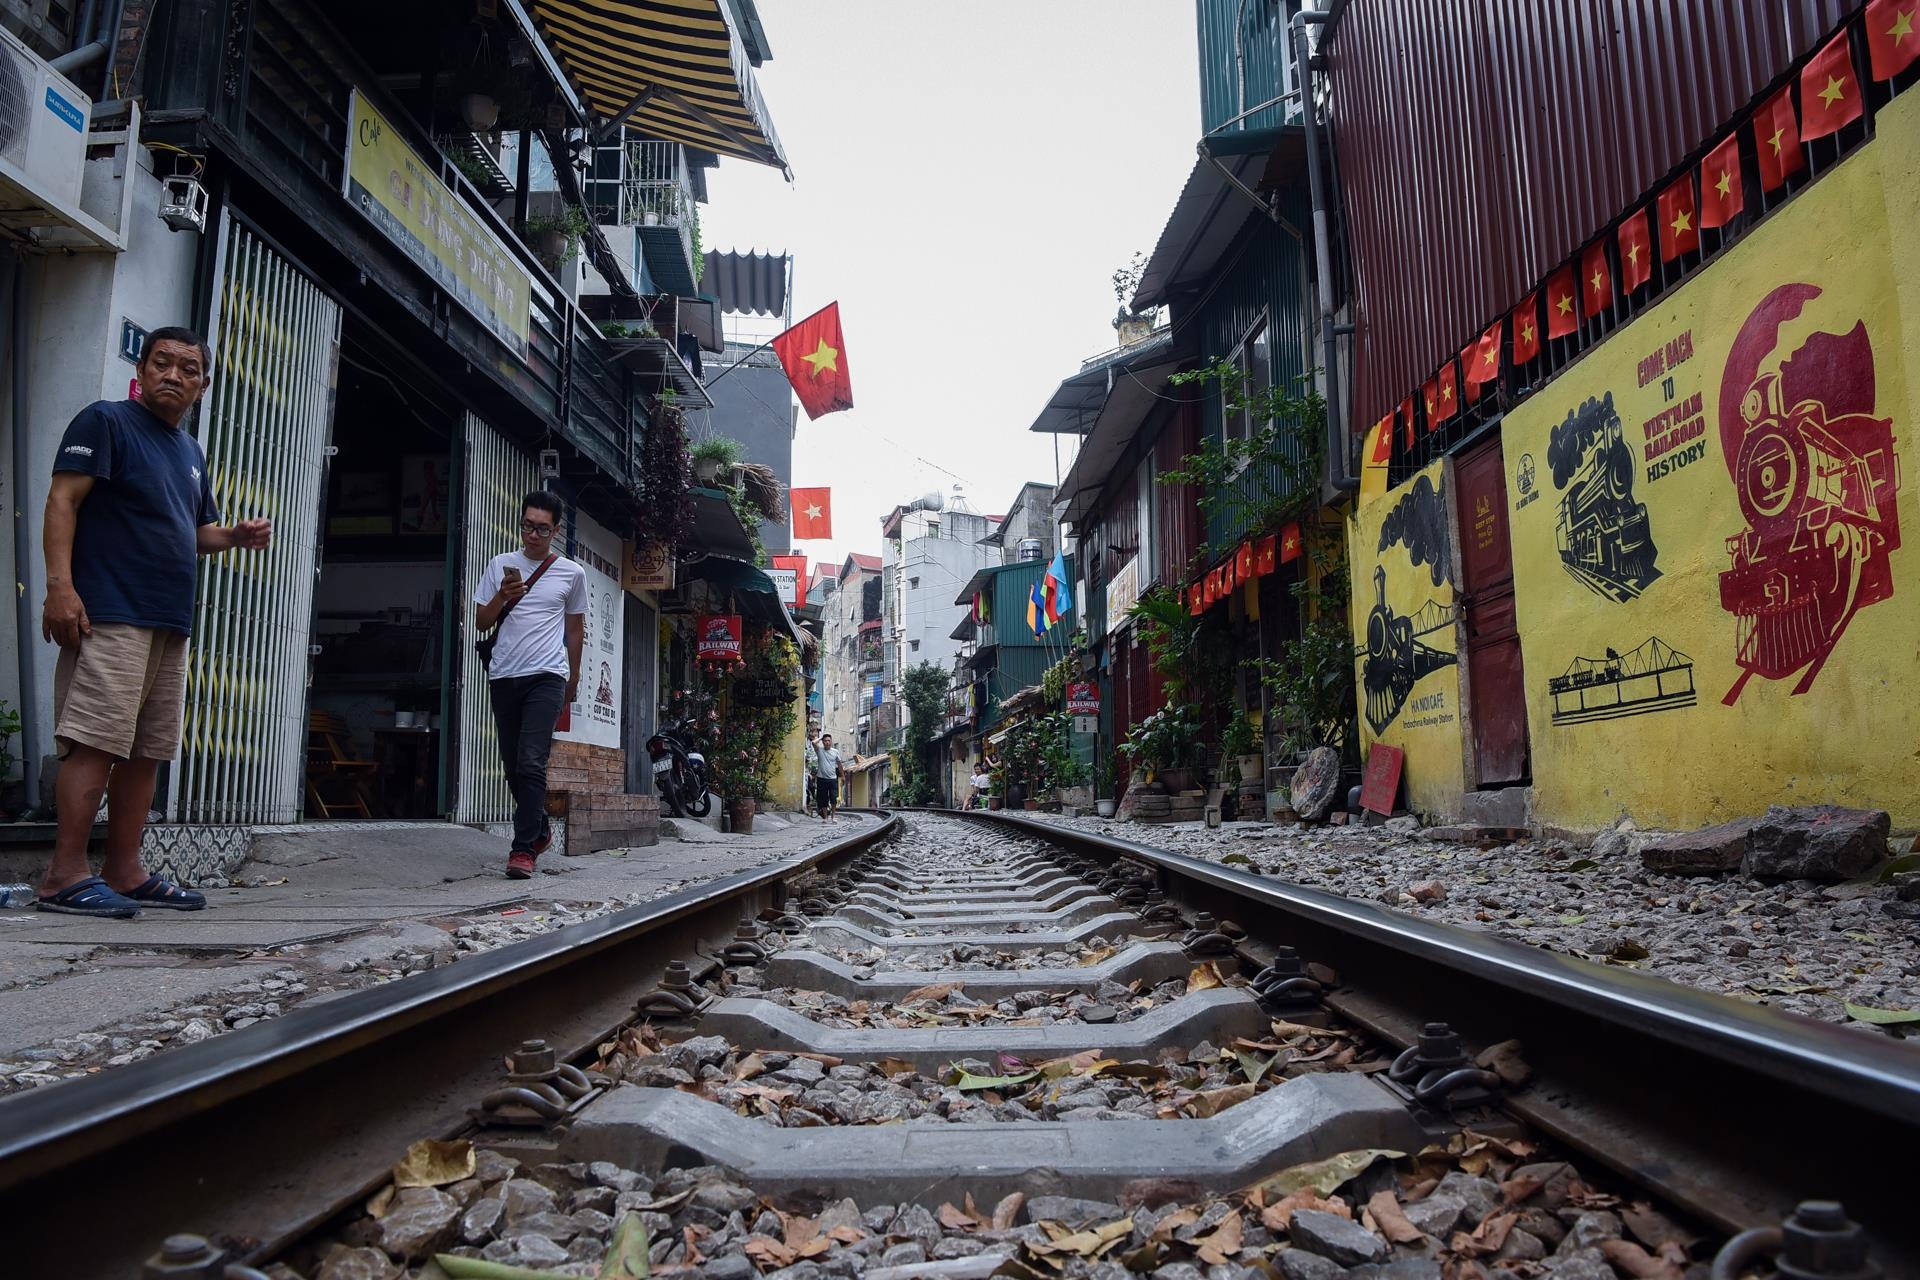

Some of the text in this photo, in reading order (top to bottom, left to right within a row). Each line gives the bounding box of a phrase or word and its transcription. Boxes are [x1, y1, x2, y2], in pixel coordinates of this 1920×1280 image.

[1637, 328, 1694, 388] COME BACK
[1662, 376, 1675, 402] TO
[1643, 391, 1703, 440] VIETNAM
[1644, 415, 1705, 461] RAILROAD
[1646, 439, 1706, 483] HISTORY
[777, 575, 797, 583] STATION
[699, 641, 740, 651] RAILWAY
[1067, 700, 1100, 709] RAILWAY
[1438, 713, 1454, 724] Station
